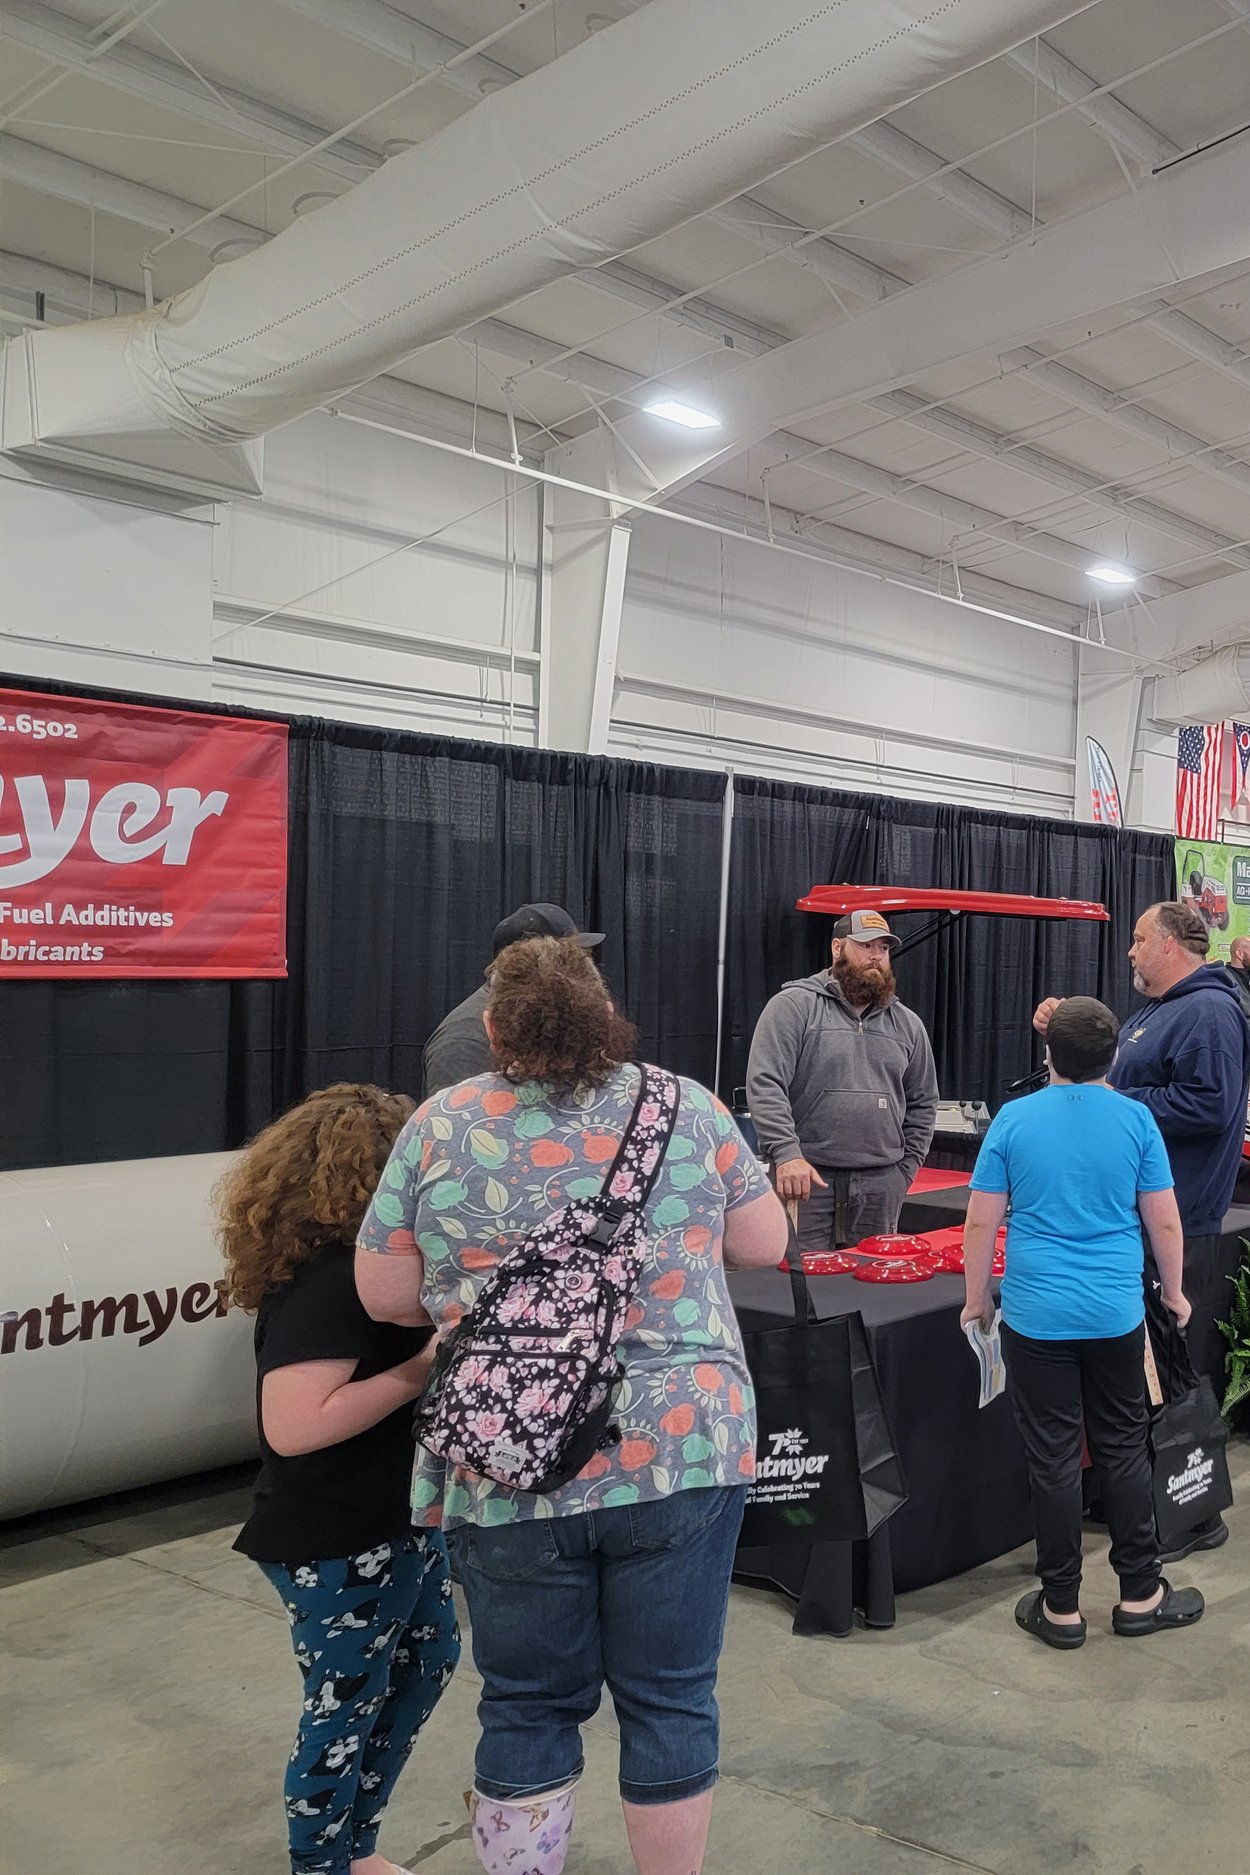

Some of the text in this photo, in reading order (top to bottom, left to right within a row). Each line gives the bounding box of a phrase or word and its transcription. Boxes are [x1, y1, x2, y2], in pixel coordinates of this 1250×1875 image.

[0, 775, 229, 889] yer
[0, 902, 174, 927] Fuel Additives
[1, 938, 105, 961] bricants
